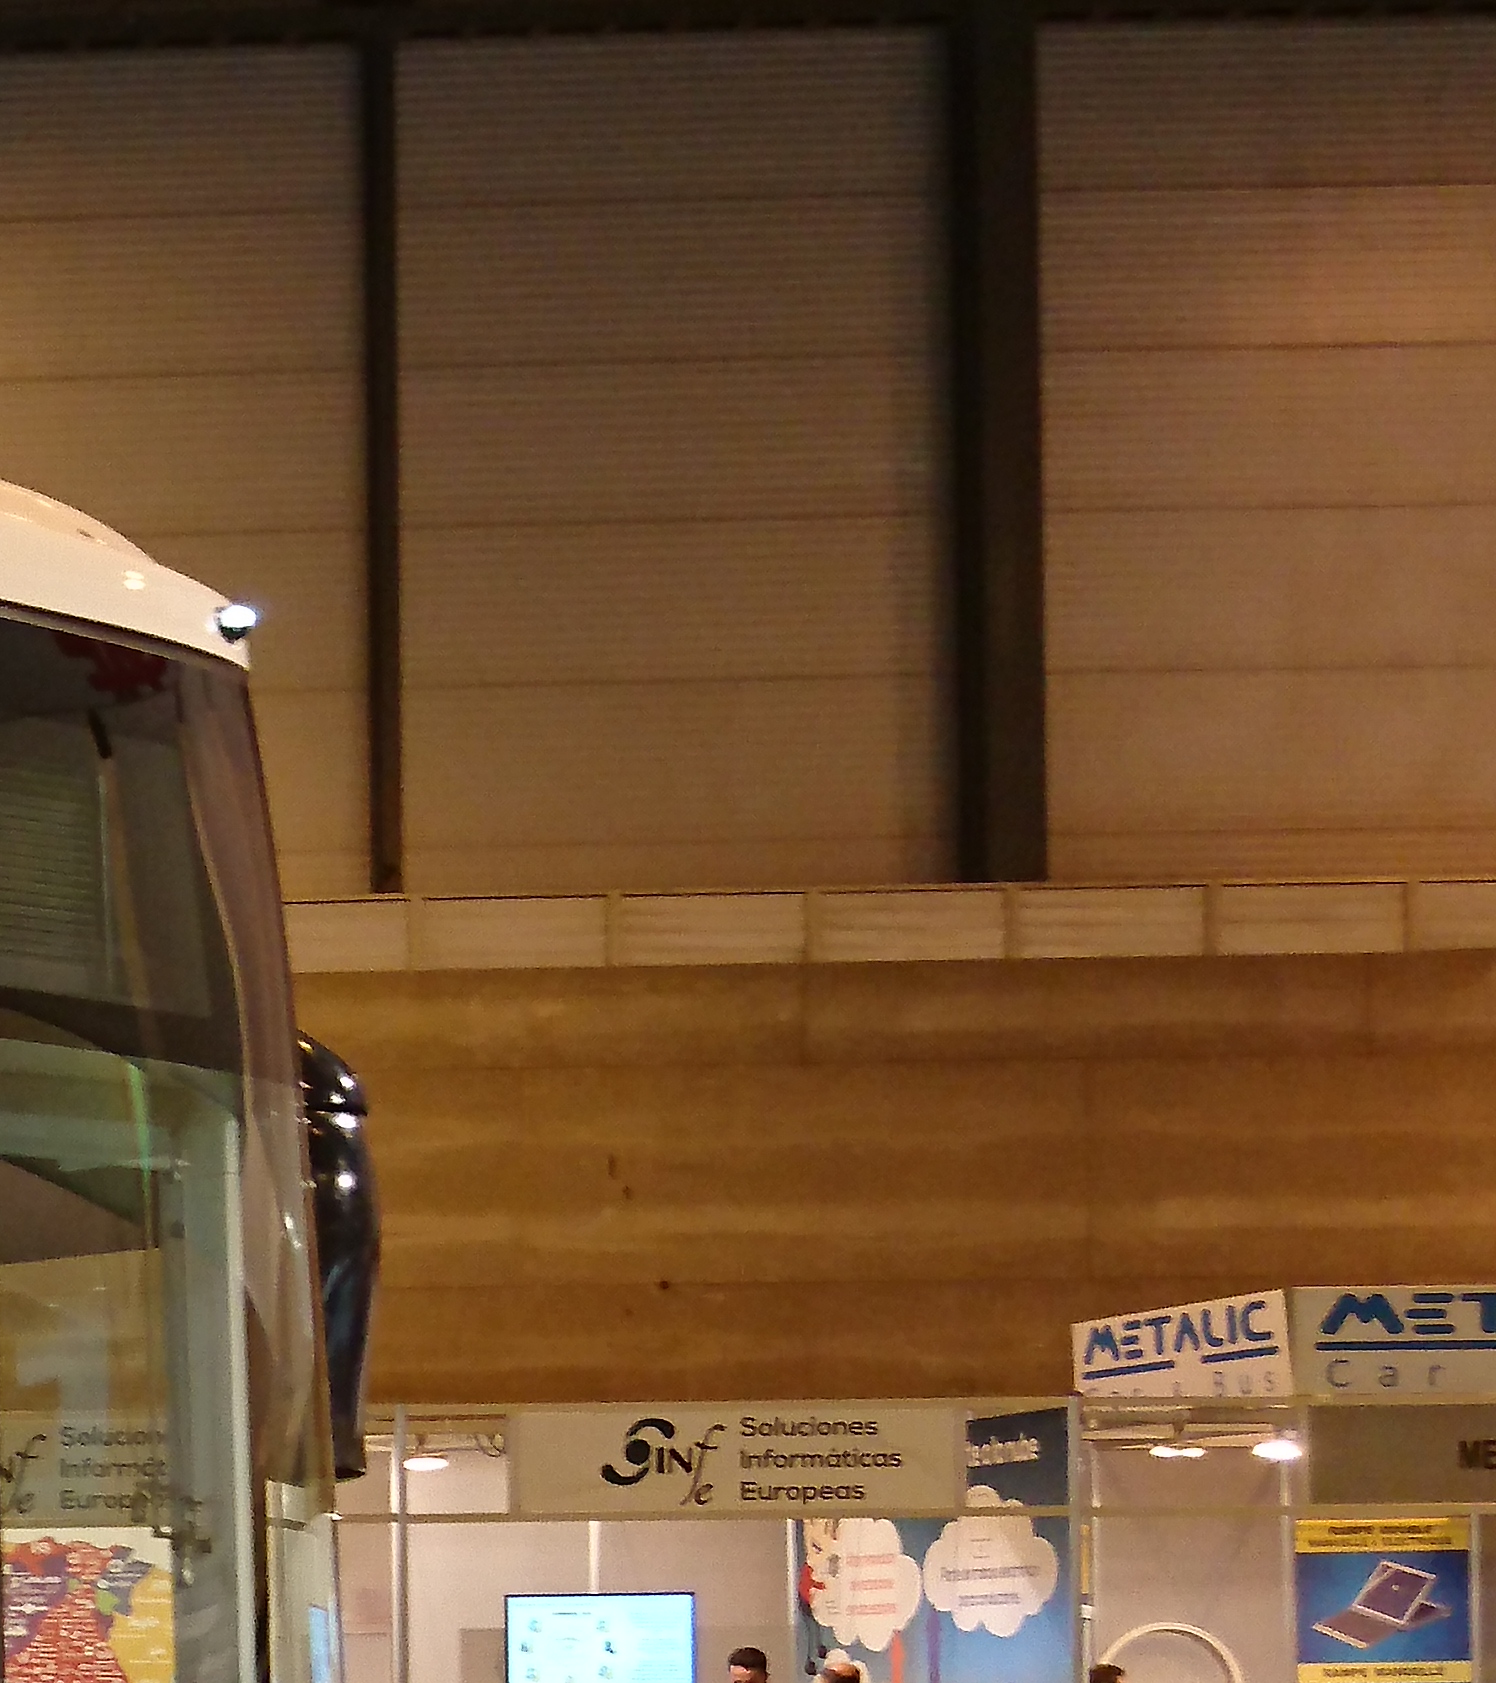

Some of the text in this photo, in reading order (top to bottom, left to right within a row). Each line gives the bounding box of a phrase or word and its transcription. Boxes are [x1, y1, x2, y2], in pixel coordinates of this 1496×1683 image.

[1085, 1299, 1274, 1365] METALIC
[740, 1416, 878, 1437] Soluciones
[740, 1448, 902, 1468] Informáticas
[740, 1481, 867, 1504] Europeas
